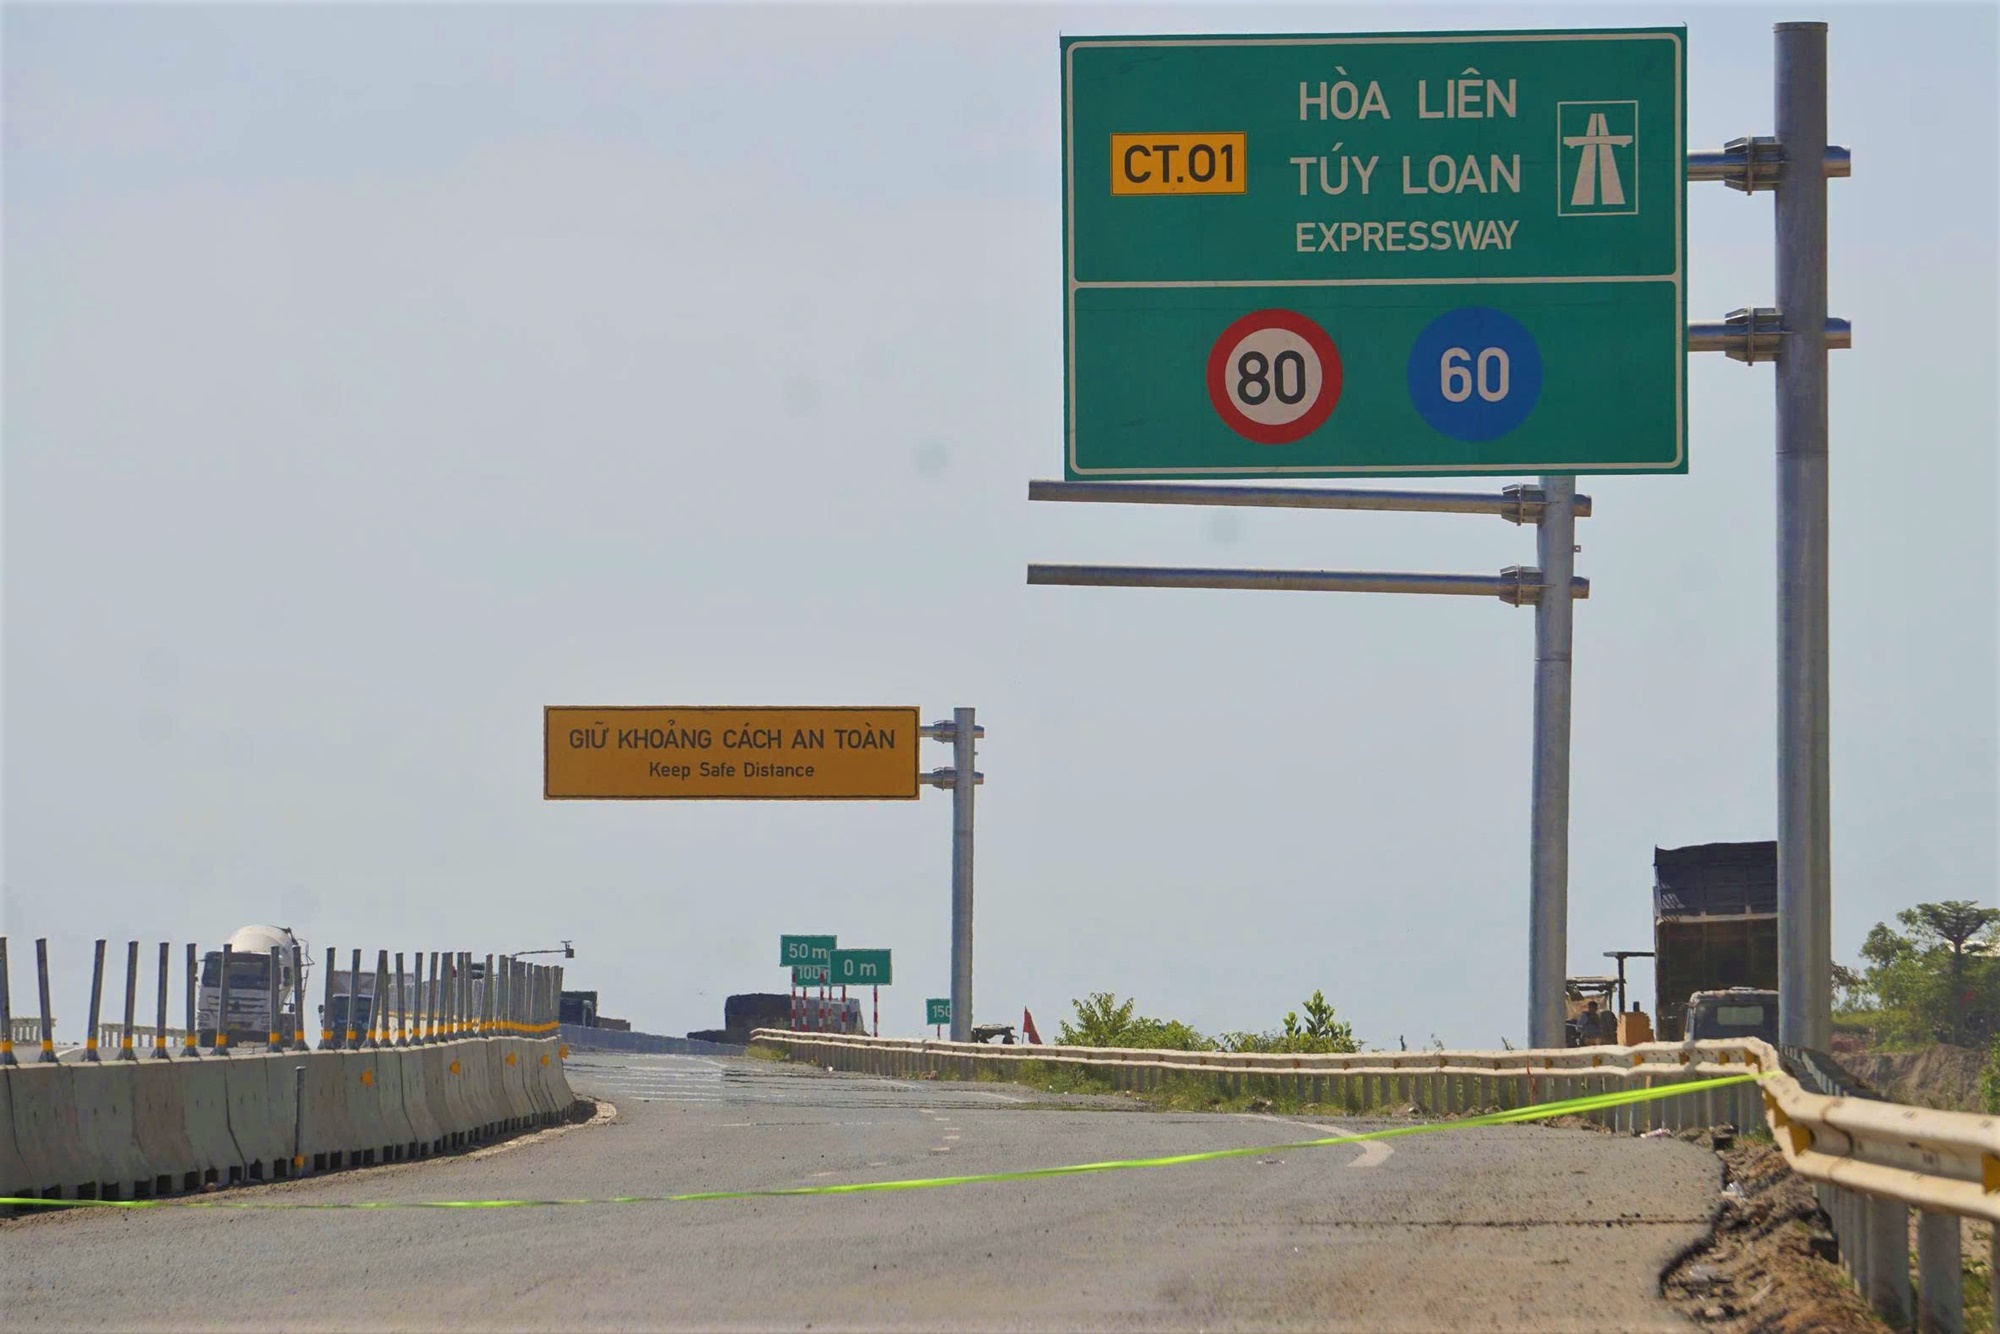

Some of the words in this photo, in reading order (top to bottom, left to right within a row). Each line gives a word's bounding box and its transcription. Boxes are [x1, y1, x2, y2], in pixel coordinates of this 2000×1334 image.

[1298, 65, 1391, 121] HÒA
[1418, 67, 1517, 119] LIÊN
[1124, 144, 1234, 184] CT.01
[1290, 142, 1378, 196] TÚY
[1402, 154, 1521, 194] LOAN
[1296, 220, 1519, 253] EXPRESSWAY
[1236, 350, 1307, 406] 80
[1440, 347, 1510, 403] 60
[569, 722, 608, 750] GIỮ
[618, 719, 711, 749] KHOẢNG
[723, 722, 782, 749] CÁCH
[791, 729, 824, 749] AN
[834, 722, 896, 749] TOÀN
[649, 762, 691, 780] Keep
[700, 762, 736, 777] Safe
[743, 762, 815, 777] Distance
[788, 944, 808, 959] 50
[812, 947, 827, 959] m
[844, 959, 853, 976] 0
[860, 962, 877, 976] m
